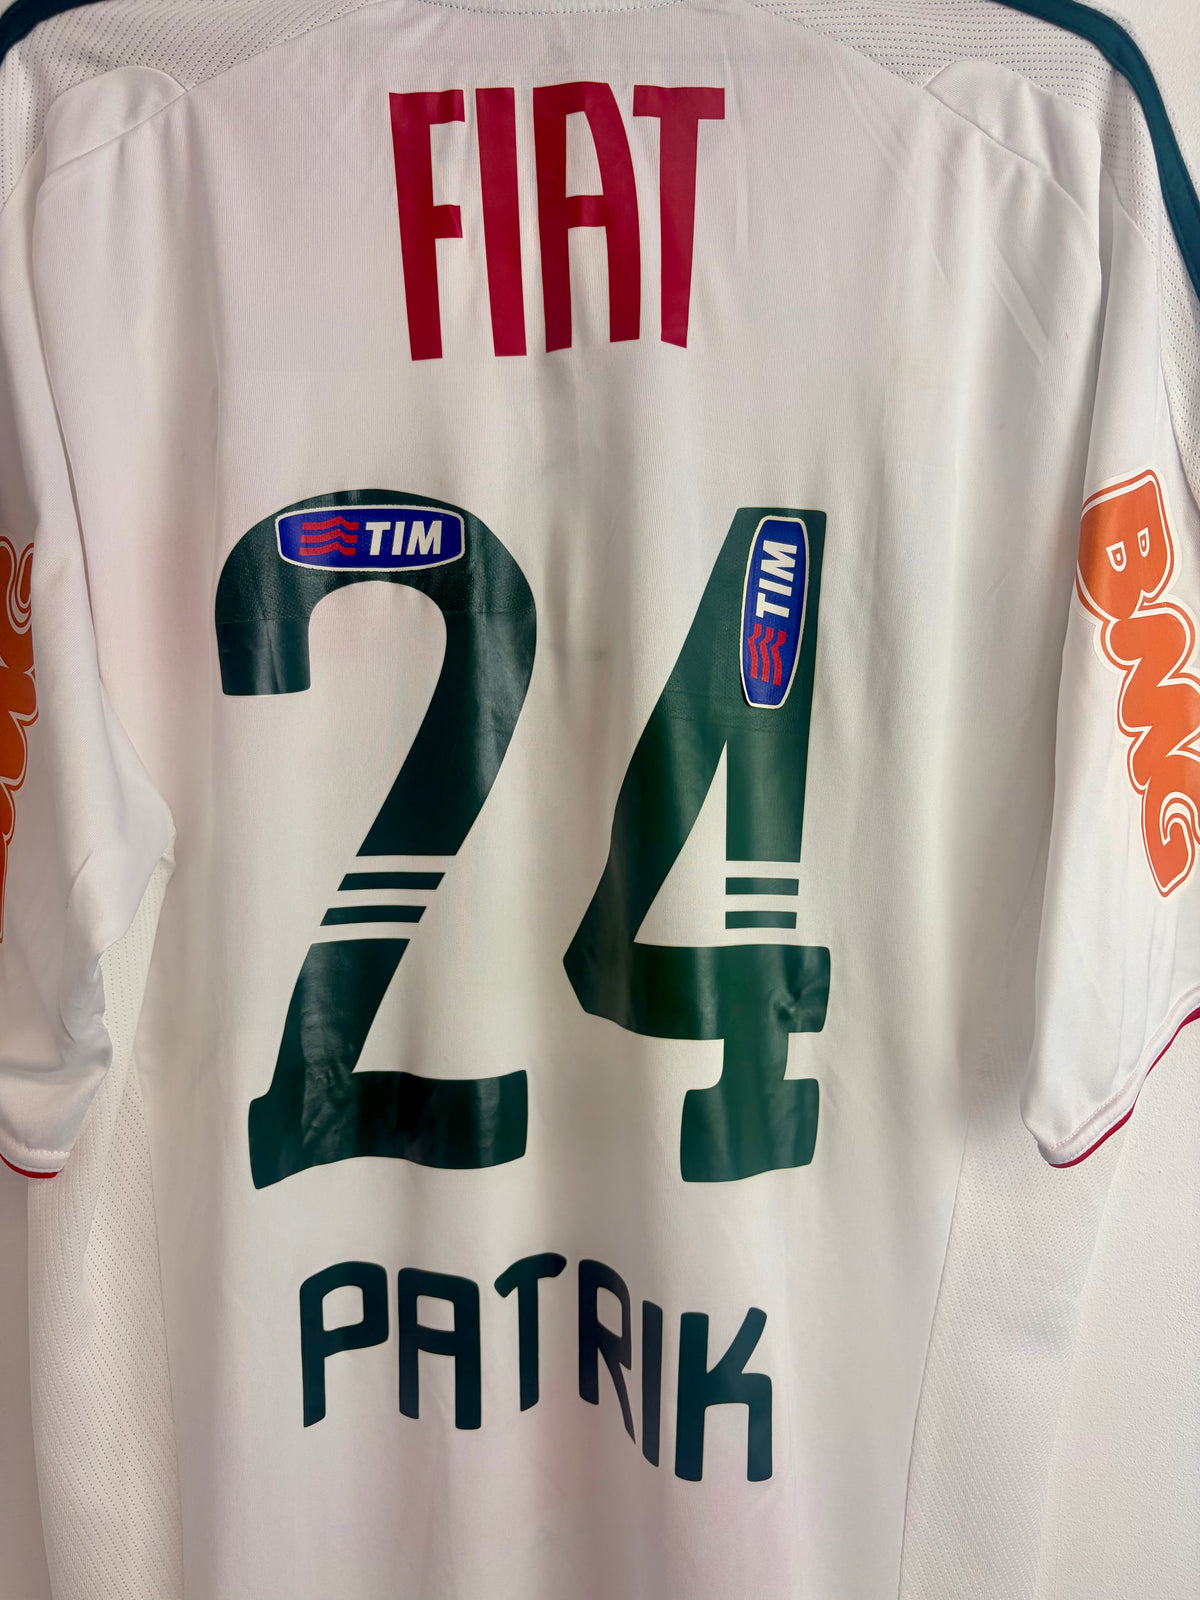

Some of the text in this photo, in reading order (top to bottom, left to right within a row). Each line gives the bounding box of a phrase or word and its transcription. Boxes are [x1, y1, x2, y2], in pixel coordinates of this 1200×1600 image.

[389, 81, 725, 361] FIAT
[366, 521, 442, 555] TIM
[756, 540, 798, 619] TIM
[215, 488, 831, 1190] 24
[300, 1252, 773, 1482] PATRIK
